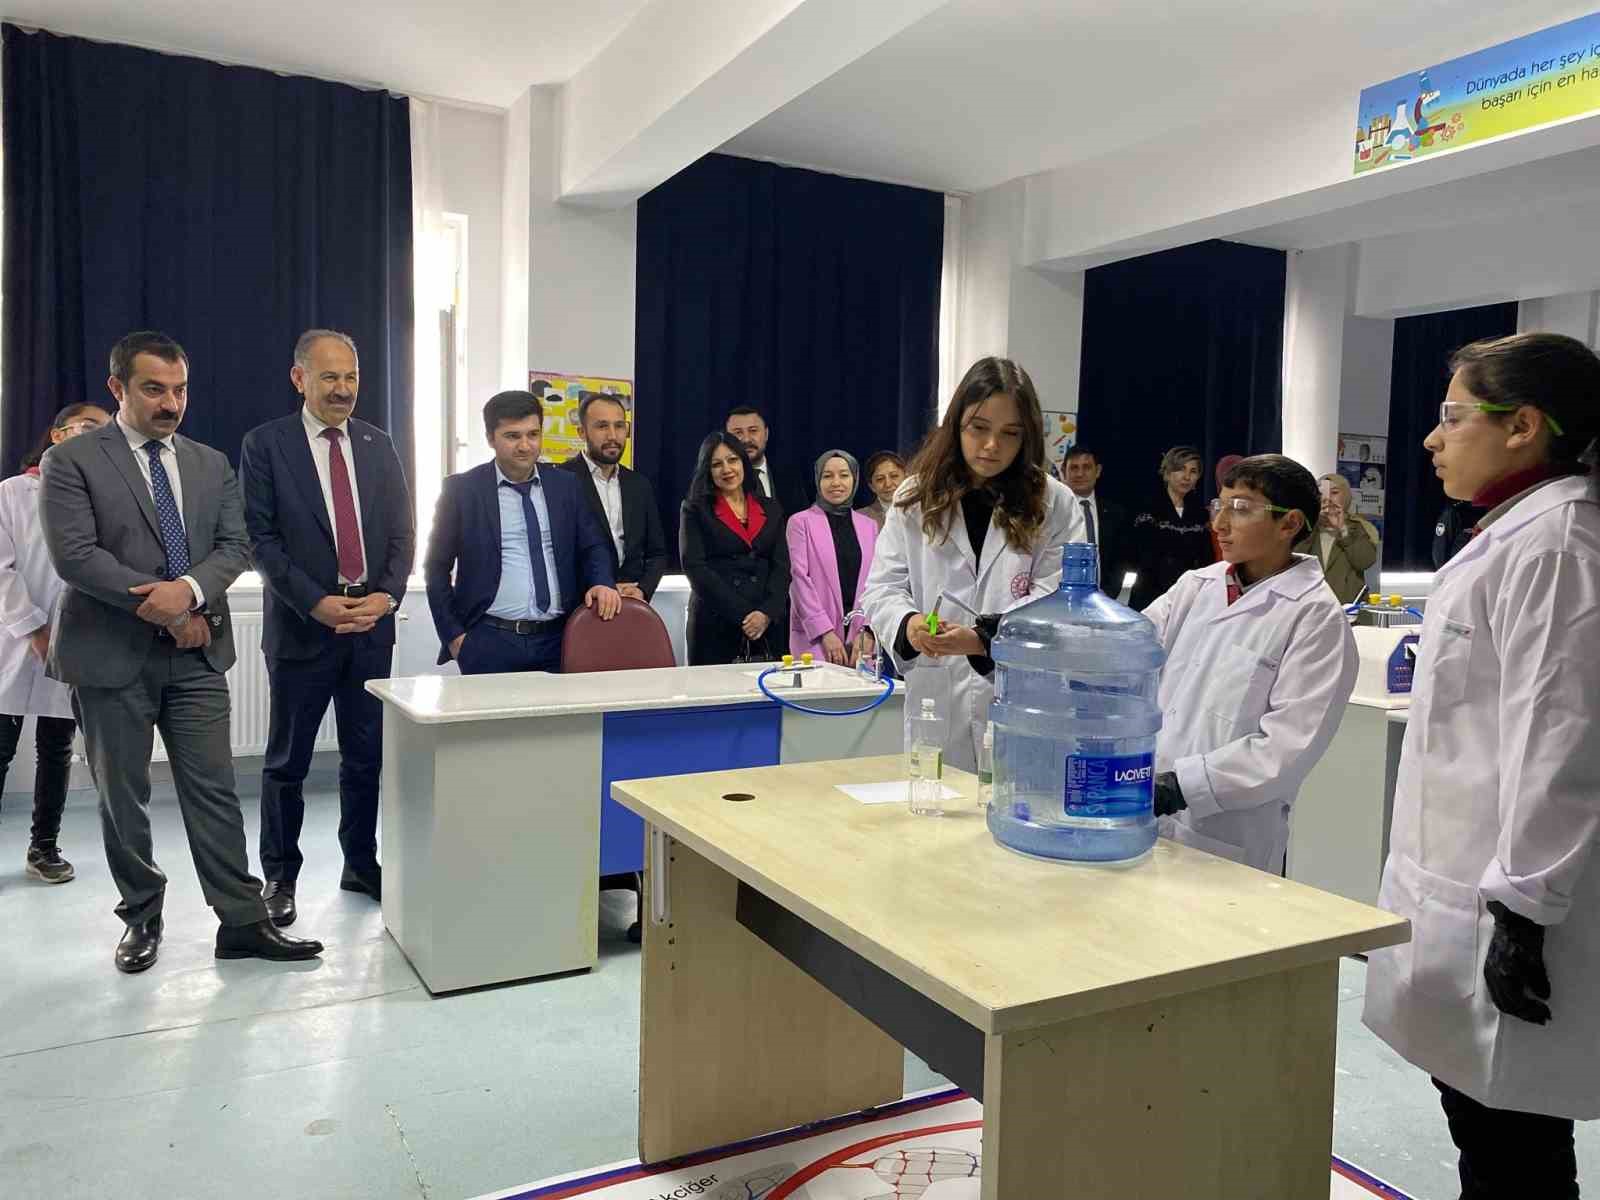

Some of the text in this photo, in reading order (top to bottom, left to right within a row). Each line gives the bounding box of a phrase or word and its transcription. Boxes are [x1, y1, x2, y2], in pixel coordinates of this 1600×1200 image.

[1466, 67, 1526, 95] Dünyada
[1531, 58, 1556, 75] her
[1560, 49, 1586, 69] şey
[1481, 67, 1599, 110] başarı için en ha
[648, 1174, 719, 1200] kciğer
